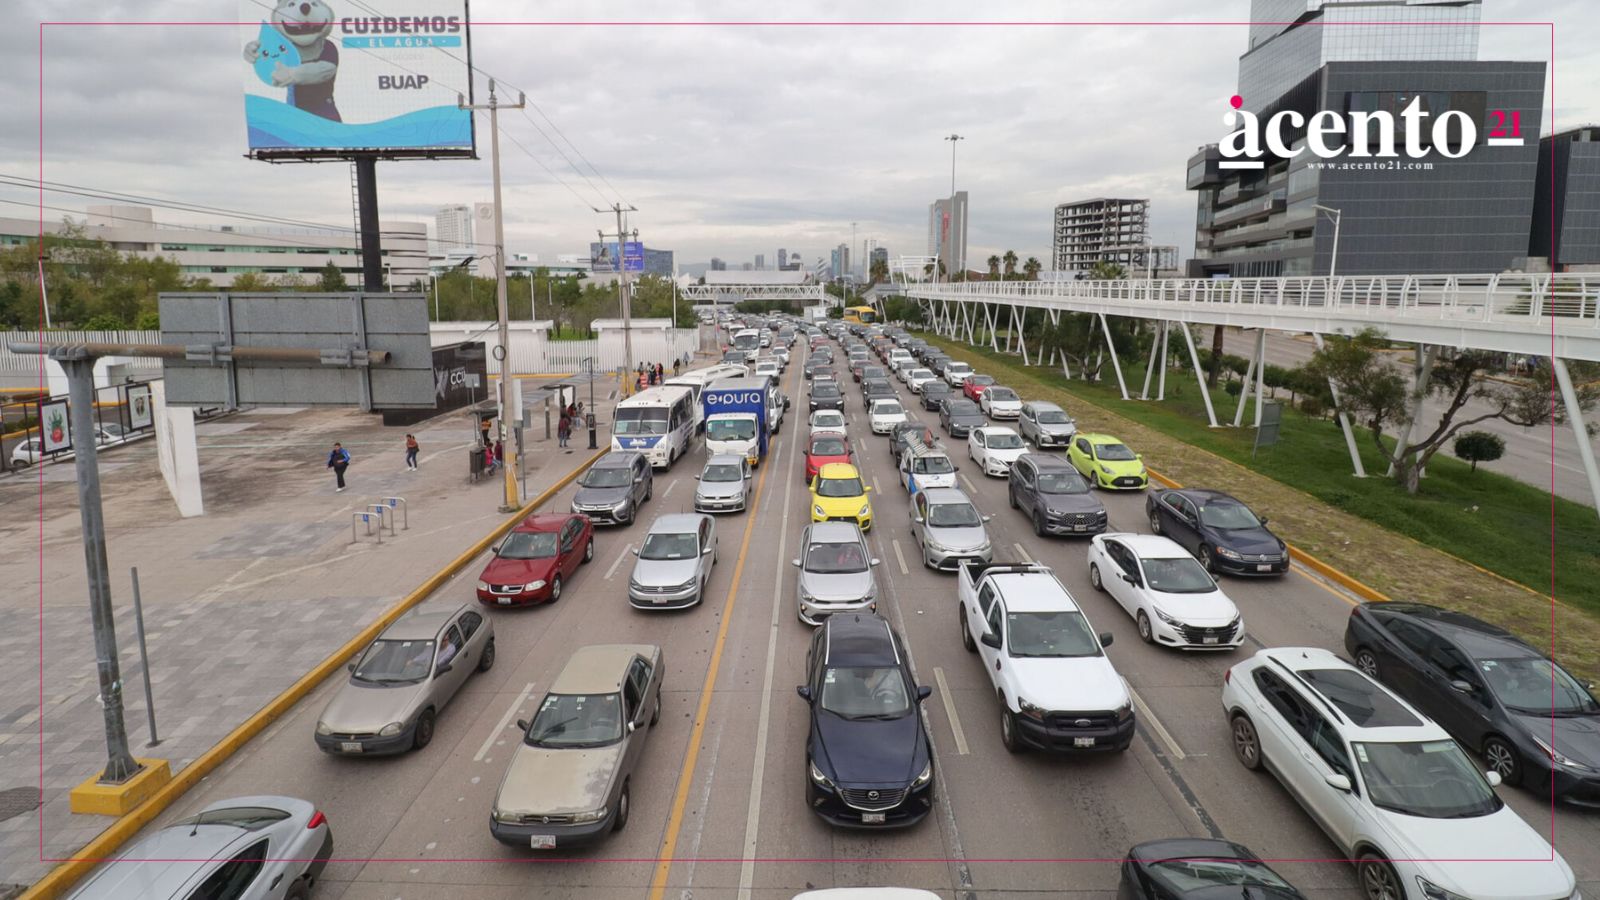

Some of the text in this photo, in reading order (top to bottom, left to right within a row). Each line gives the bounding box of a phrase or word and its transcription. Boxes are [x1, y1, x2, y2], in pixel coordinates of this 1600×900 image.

[341, 16, 461, 34] CUIDEMOS
[369, 37, 434, 47] EL AGUA
[378, 74, 429, 90] BUAP
